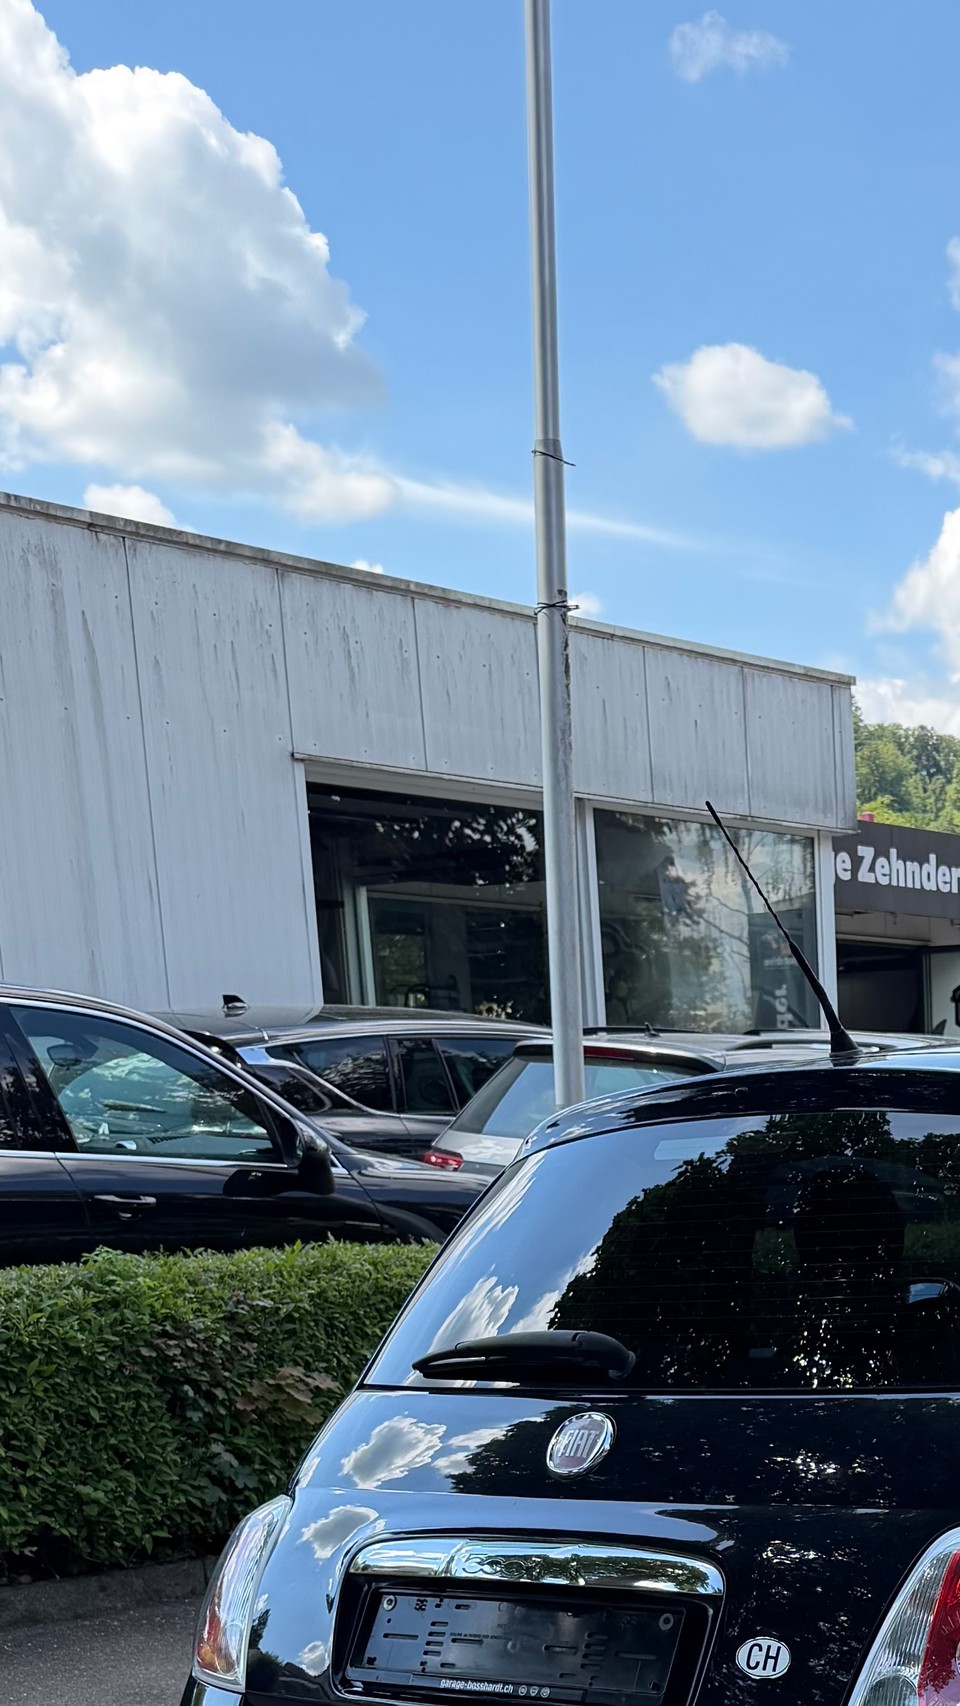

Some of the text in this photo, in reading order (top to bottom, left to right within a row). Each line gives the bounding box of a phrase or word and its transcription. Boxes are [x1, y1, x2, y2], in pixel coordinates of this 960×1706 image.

[557, 1429, 600, 1458] FIAT
[746, 1643, 781, 1673] CH
[440, 1678, 514, 1694] garage-bosshardt.ch
